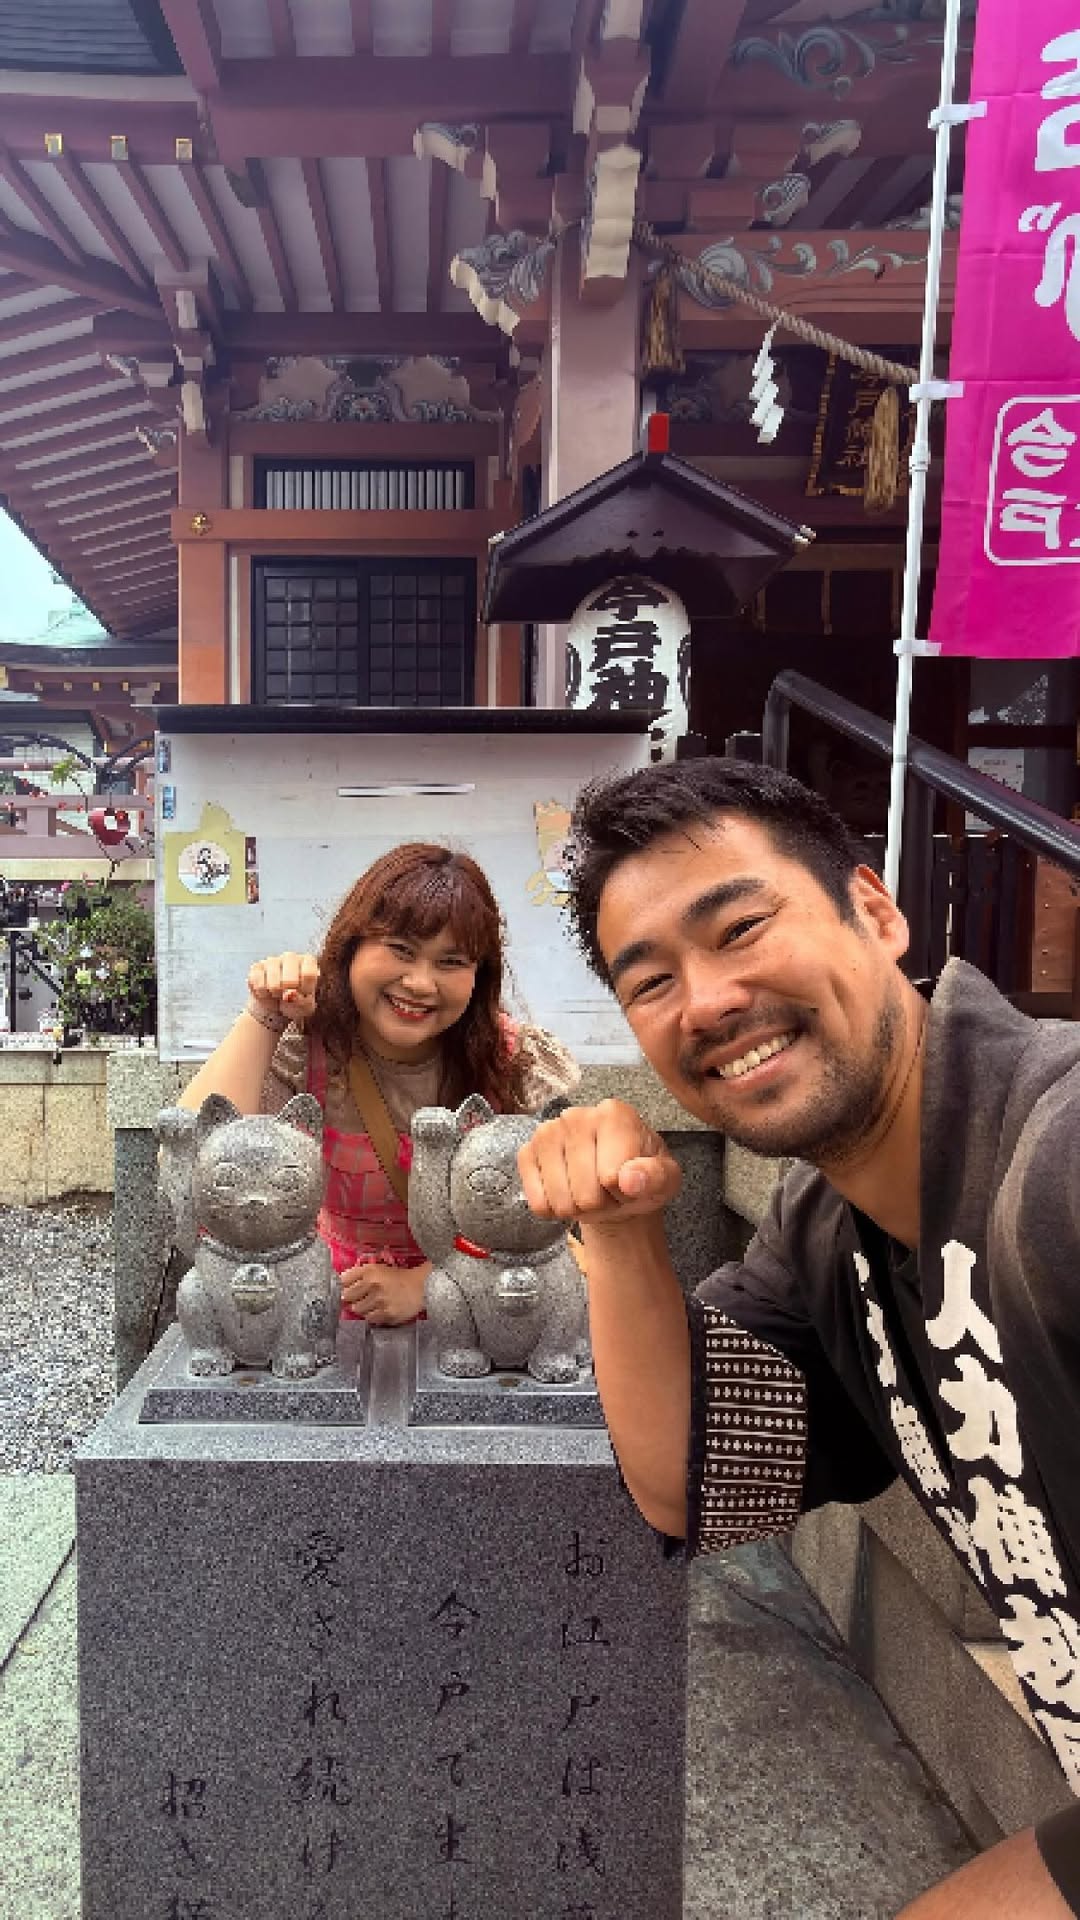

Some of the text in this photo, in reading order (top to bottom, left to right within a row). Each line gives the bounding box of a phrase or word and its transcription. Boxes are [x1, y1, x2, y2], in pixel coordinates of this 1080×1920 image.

[586, 575, 673, 763] 今戸神
[293, 1530, 351, 1920] 愛され続け
